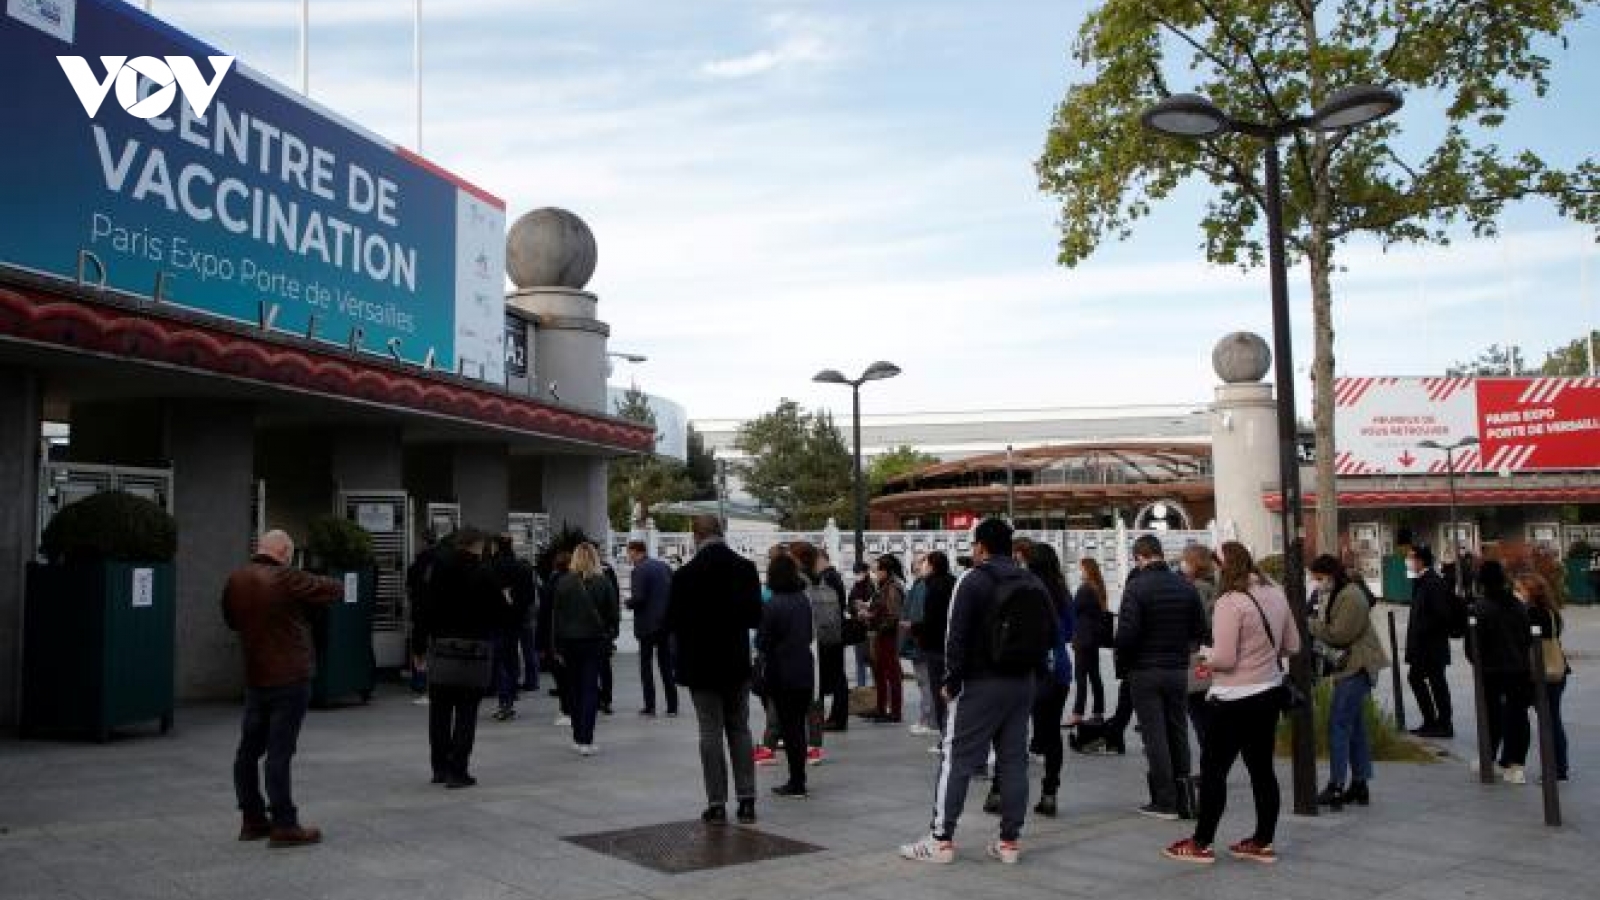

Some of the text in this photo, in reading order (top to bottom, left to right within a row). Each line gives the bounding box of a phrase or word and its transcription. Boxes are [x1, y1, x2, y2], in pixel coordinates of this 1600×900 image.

[92, 124, 417, 293] VACCINATION
[347, 163, 399, 227] DE
[90, 213, 414, 333] Paris Expo Porte de Versailles
